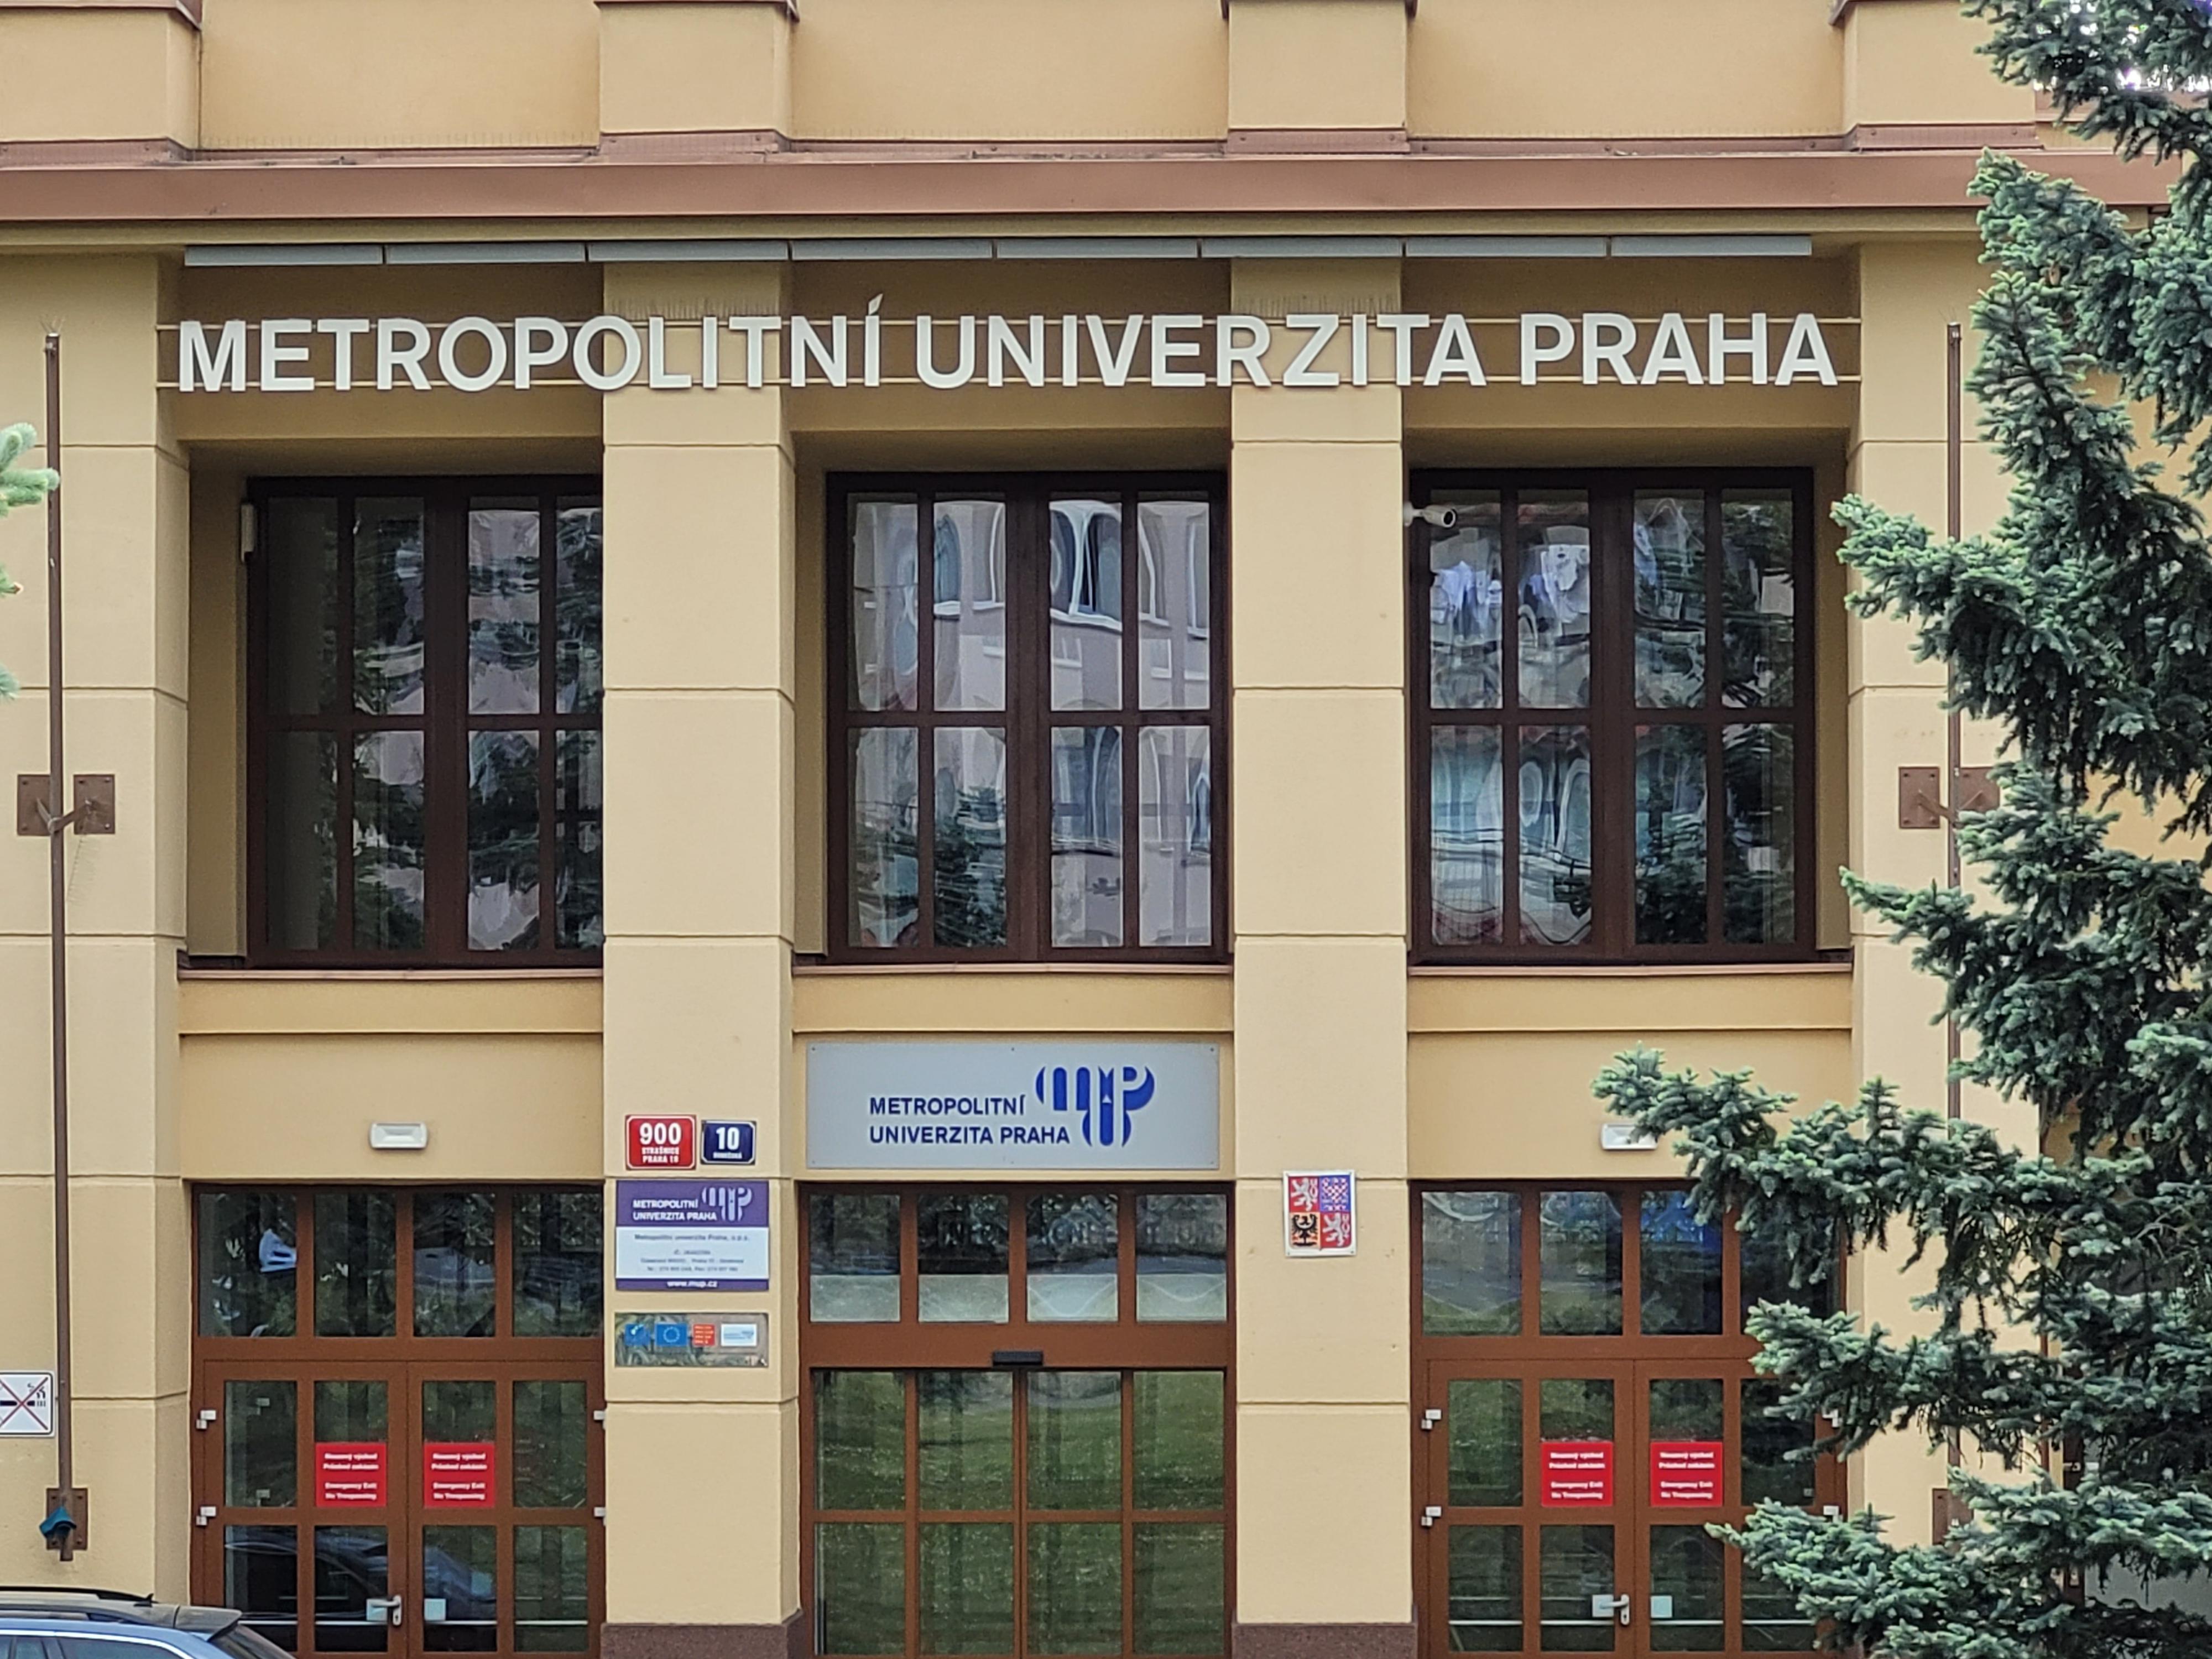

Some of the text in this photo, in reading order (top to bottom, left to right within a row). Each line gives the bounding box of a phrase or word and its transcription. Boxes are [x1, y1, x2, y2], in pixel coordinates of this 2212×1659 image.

[178, 294, 1838, 392] METROPOLITNÍ UNIVERZITA PRAHA
[870, 1095, 1026, 1115] METROPOLITNÍ
[639, 1123, 682, 1145] 900
[716, 1127, 740, 1150] 10
[870, 1126, 1070, 1144] UNIVERZITA PRAHA
[643, 1155, 667, 1164] PRAHA
[633, 1198, 698, 1209] METROPOLITNÍ
[633, 1212, 717, 1220] UNIVERZITA PRAHA
